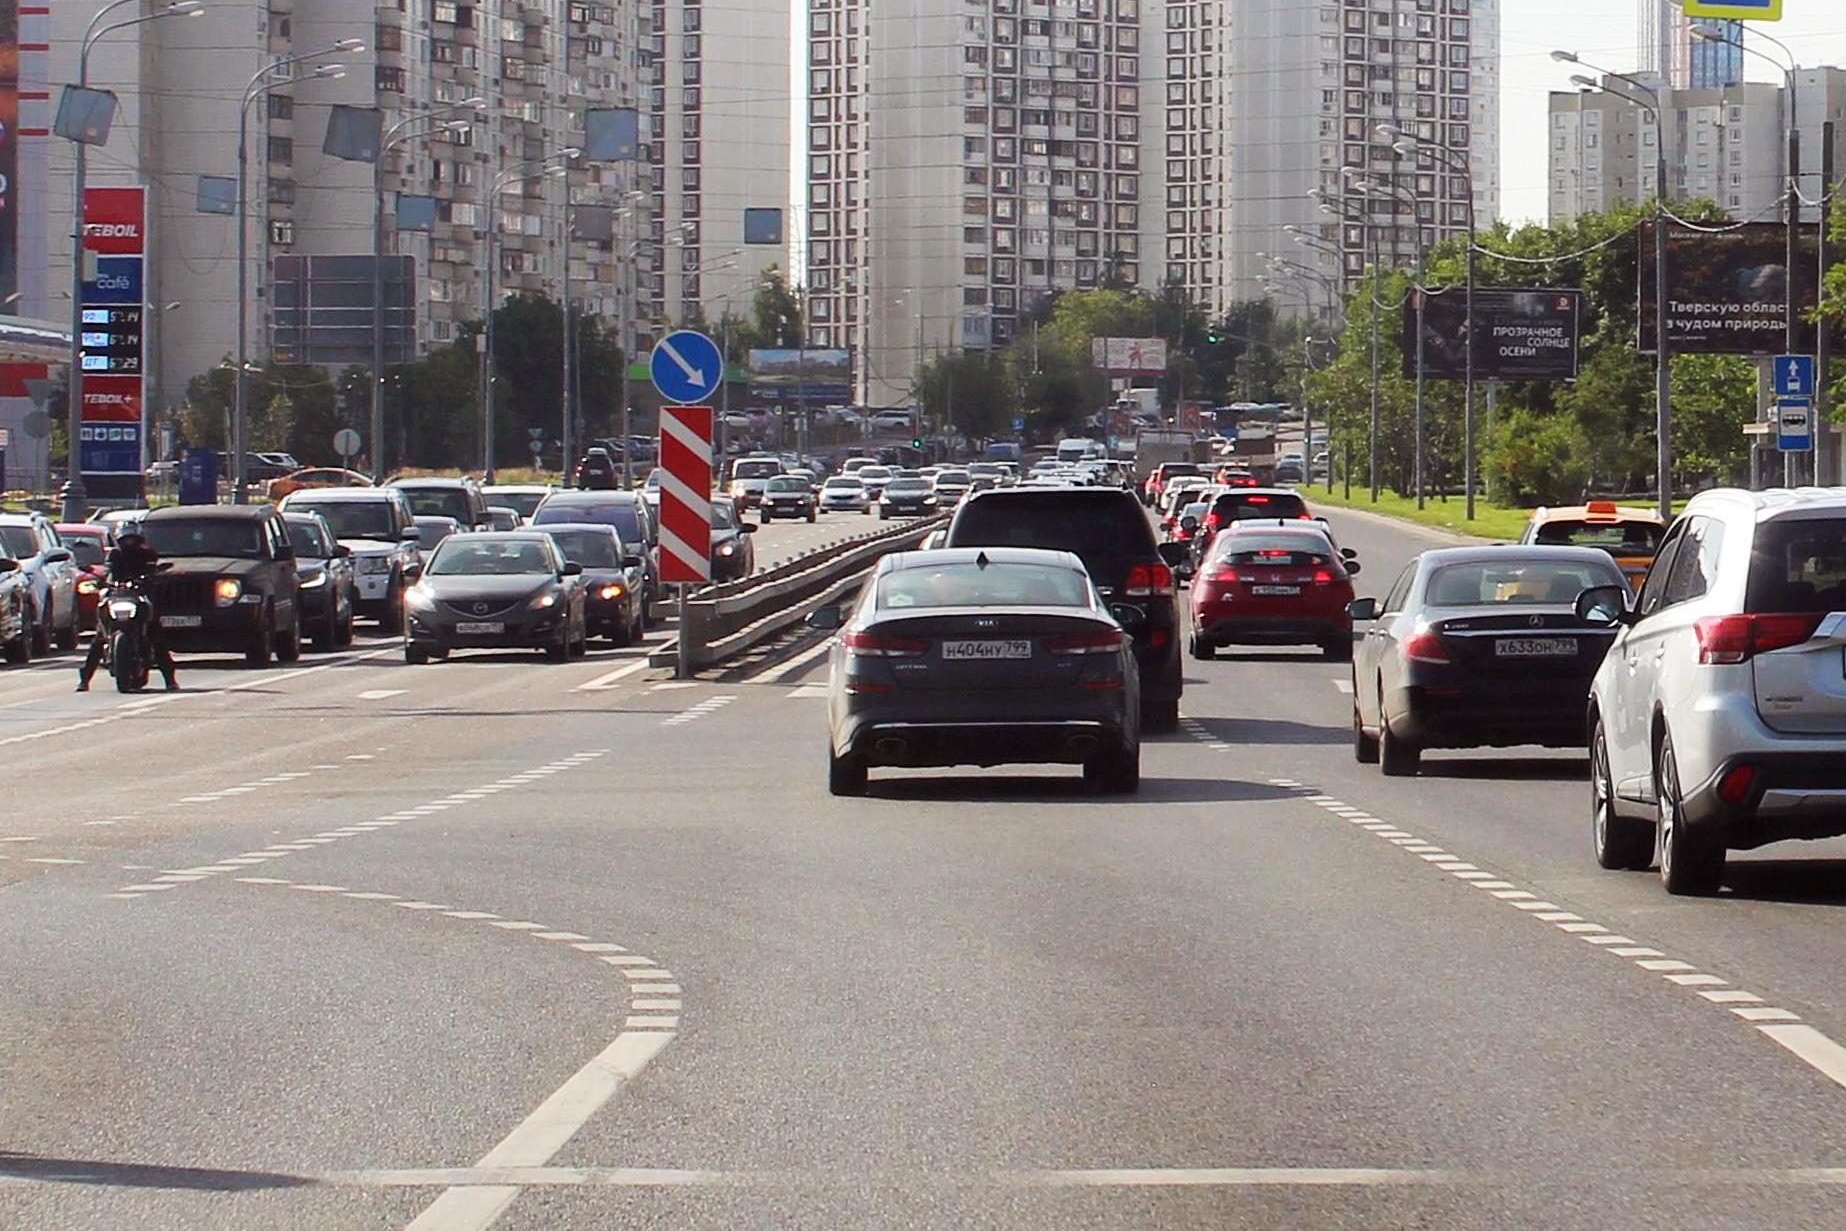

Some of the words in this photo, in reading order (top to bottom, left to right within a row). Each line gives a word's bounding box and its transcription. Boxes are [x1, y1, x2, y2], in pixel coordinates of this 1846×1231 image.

[82, 223, 139, 238] TEBOIL
[1669, 301, 1739, 315] Тверскую
[1676, 320, 1722, 331] чудом
[1493, 326, 1563, 337] ПРОЗРАЧНОЕ
[1527, 337, 1570, 348] СОЛНЦЕ
[1499, 347, 1536, 357] ОСЕНИ
